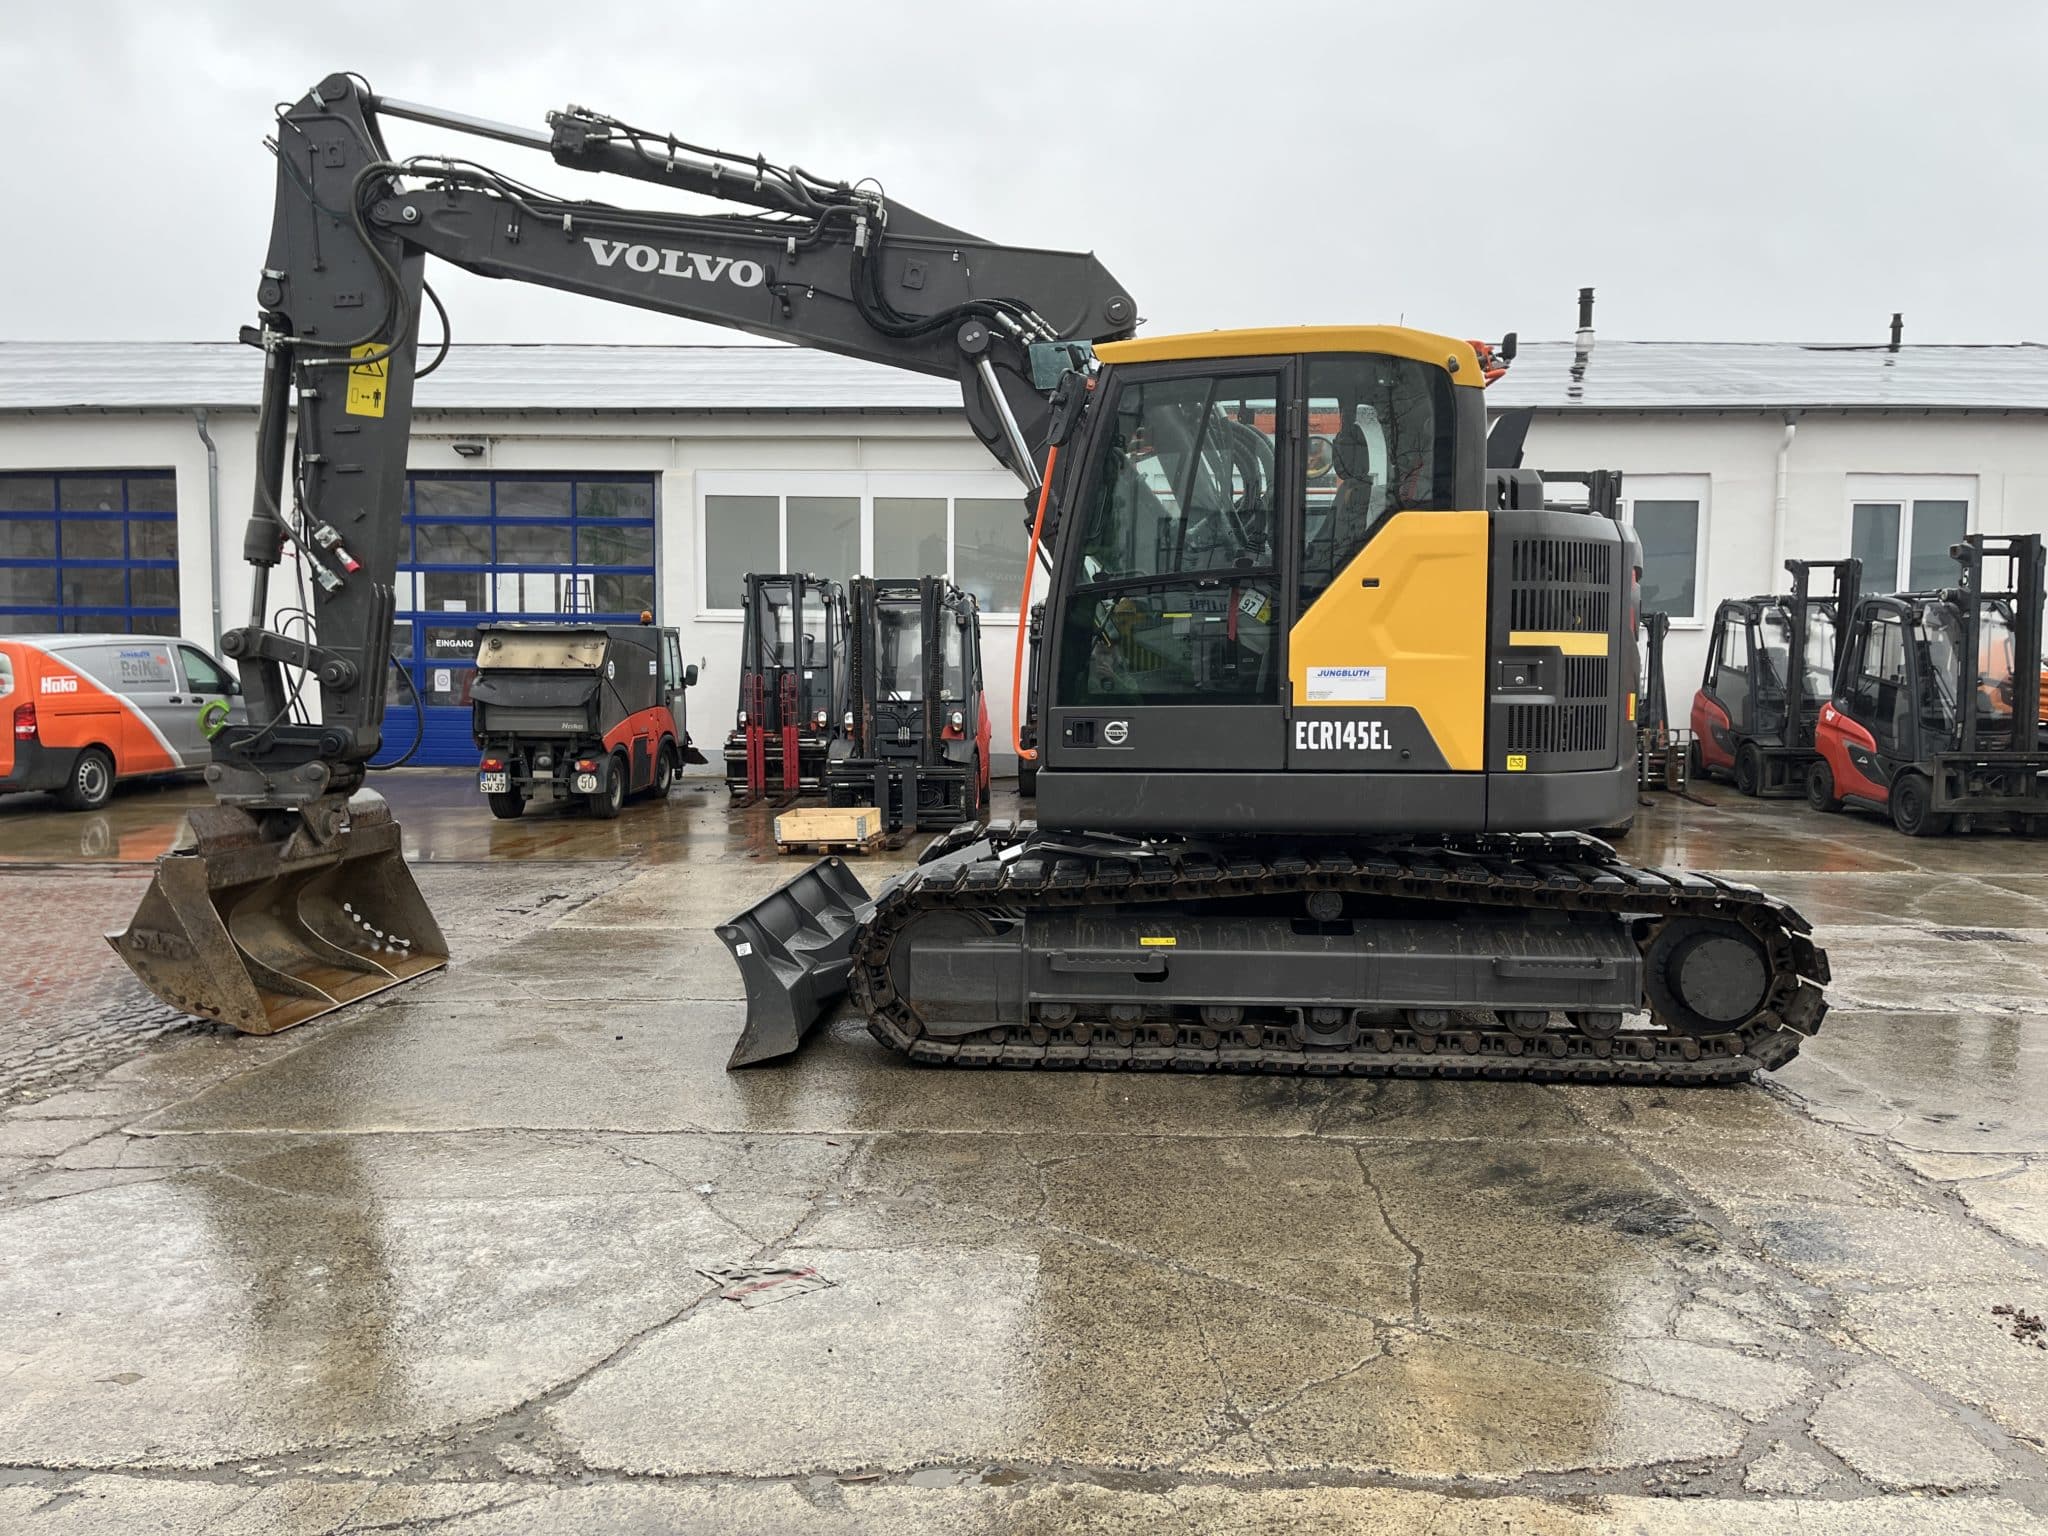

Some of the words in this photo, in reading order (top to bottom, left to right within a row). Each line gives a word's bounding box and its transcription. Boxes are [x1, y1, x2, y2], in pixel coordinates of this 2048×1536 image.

[583, 237, 763, 287] VOLVO
[1241, 599, 1256, 612] 97
[41, 676, 78, 694] Hako
[1296, 721, 1392, 749] ECR145EL
[481, 783, 493, 792] SW
[495, 783, 505, 792] 37
[580, 777, 595, 790] 50
